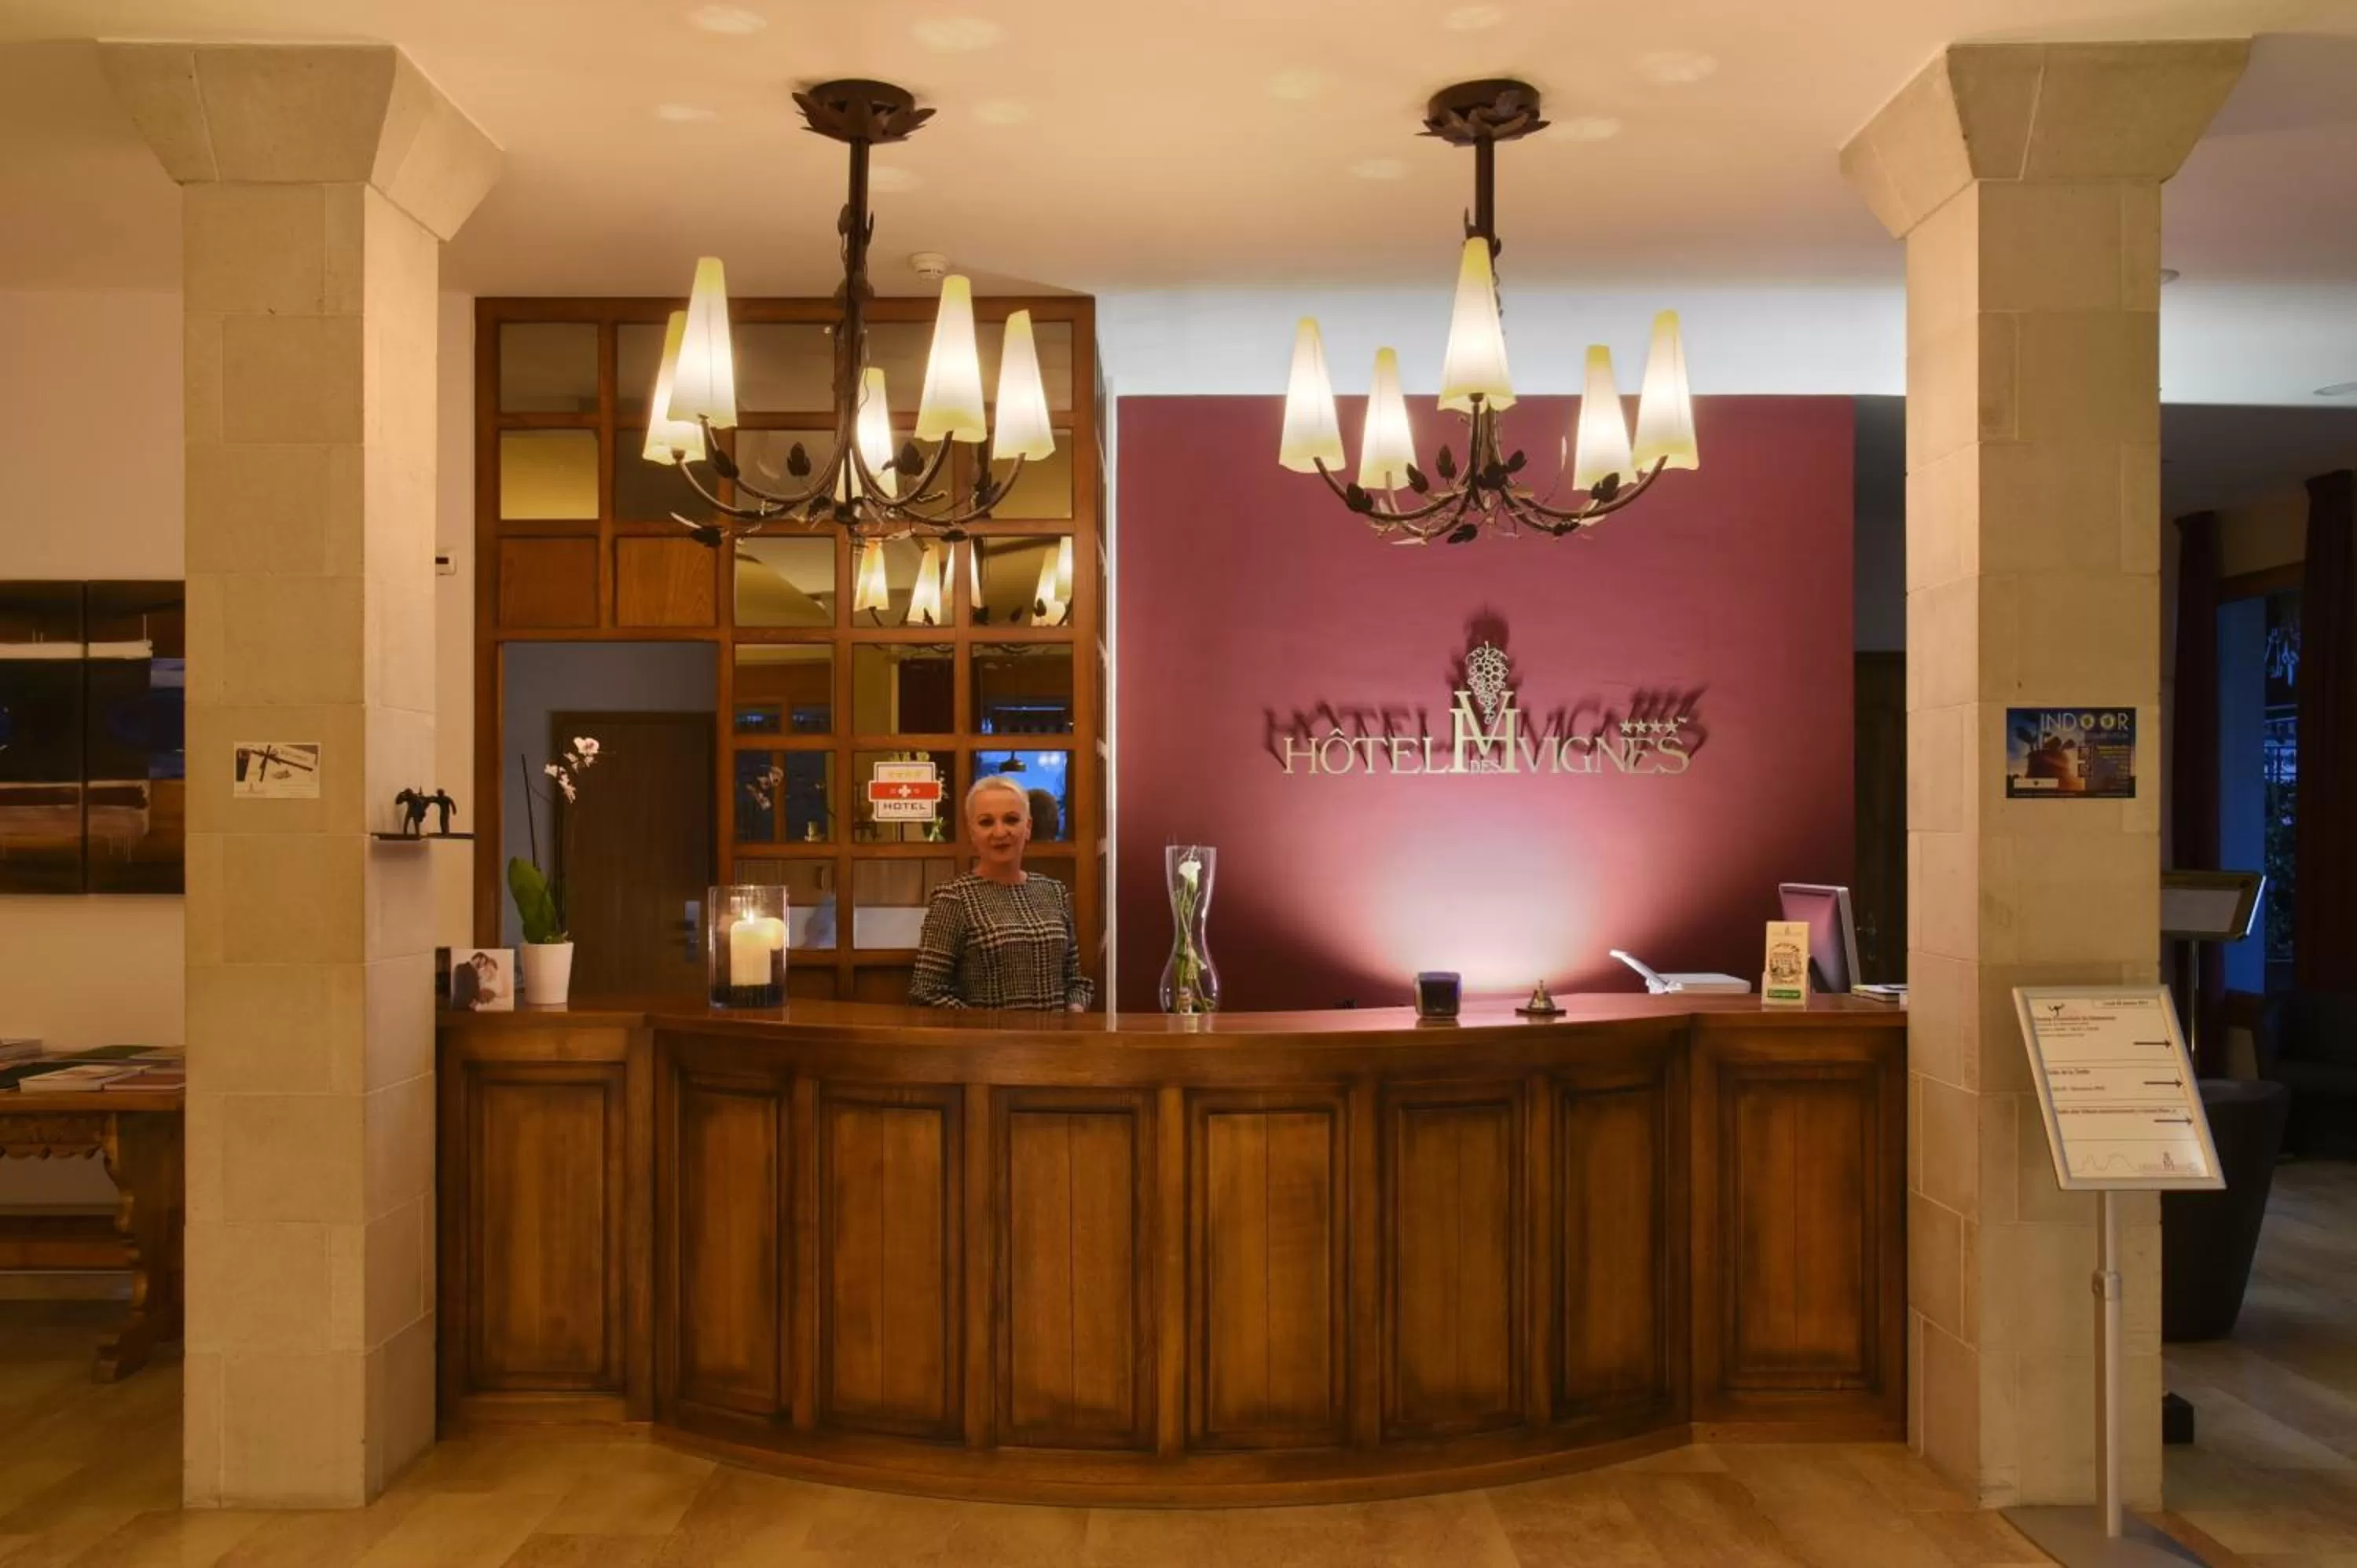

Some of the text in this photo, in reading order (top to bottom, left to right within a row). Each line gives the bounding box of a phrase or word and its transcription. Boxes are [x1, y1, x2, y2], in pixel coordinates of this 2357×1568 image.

[2040, 712, 2129, 732] INDOOR
[1282, 727, 1690, 774] HÔTEL DES VIGNES
[882, 801, 928, 811] HOTEL
